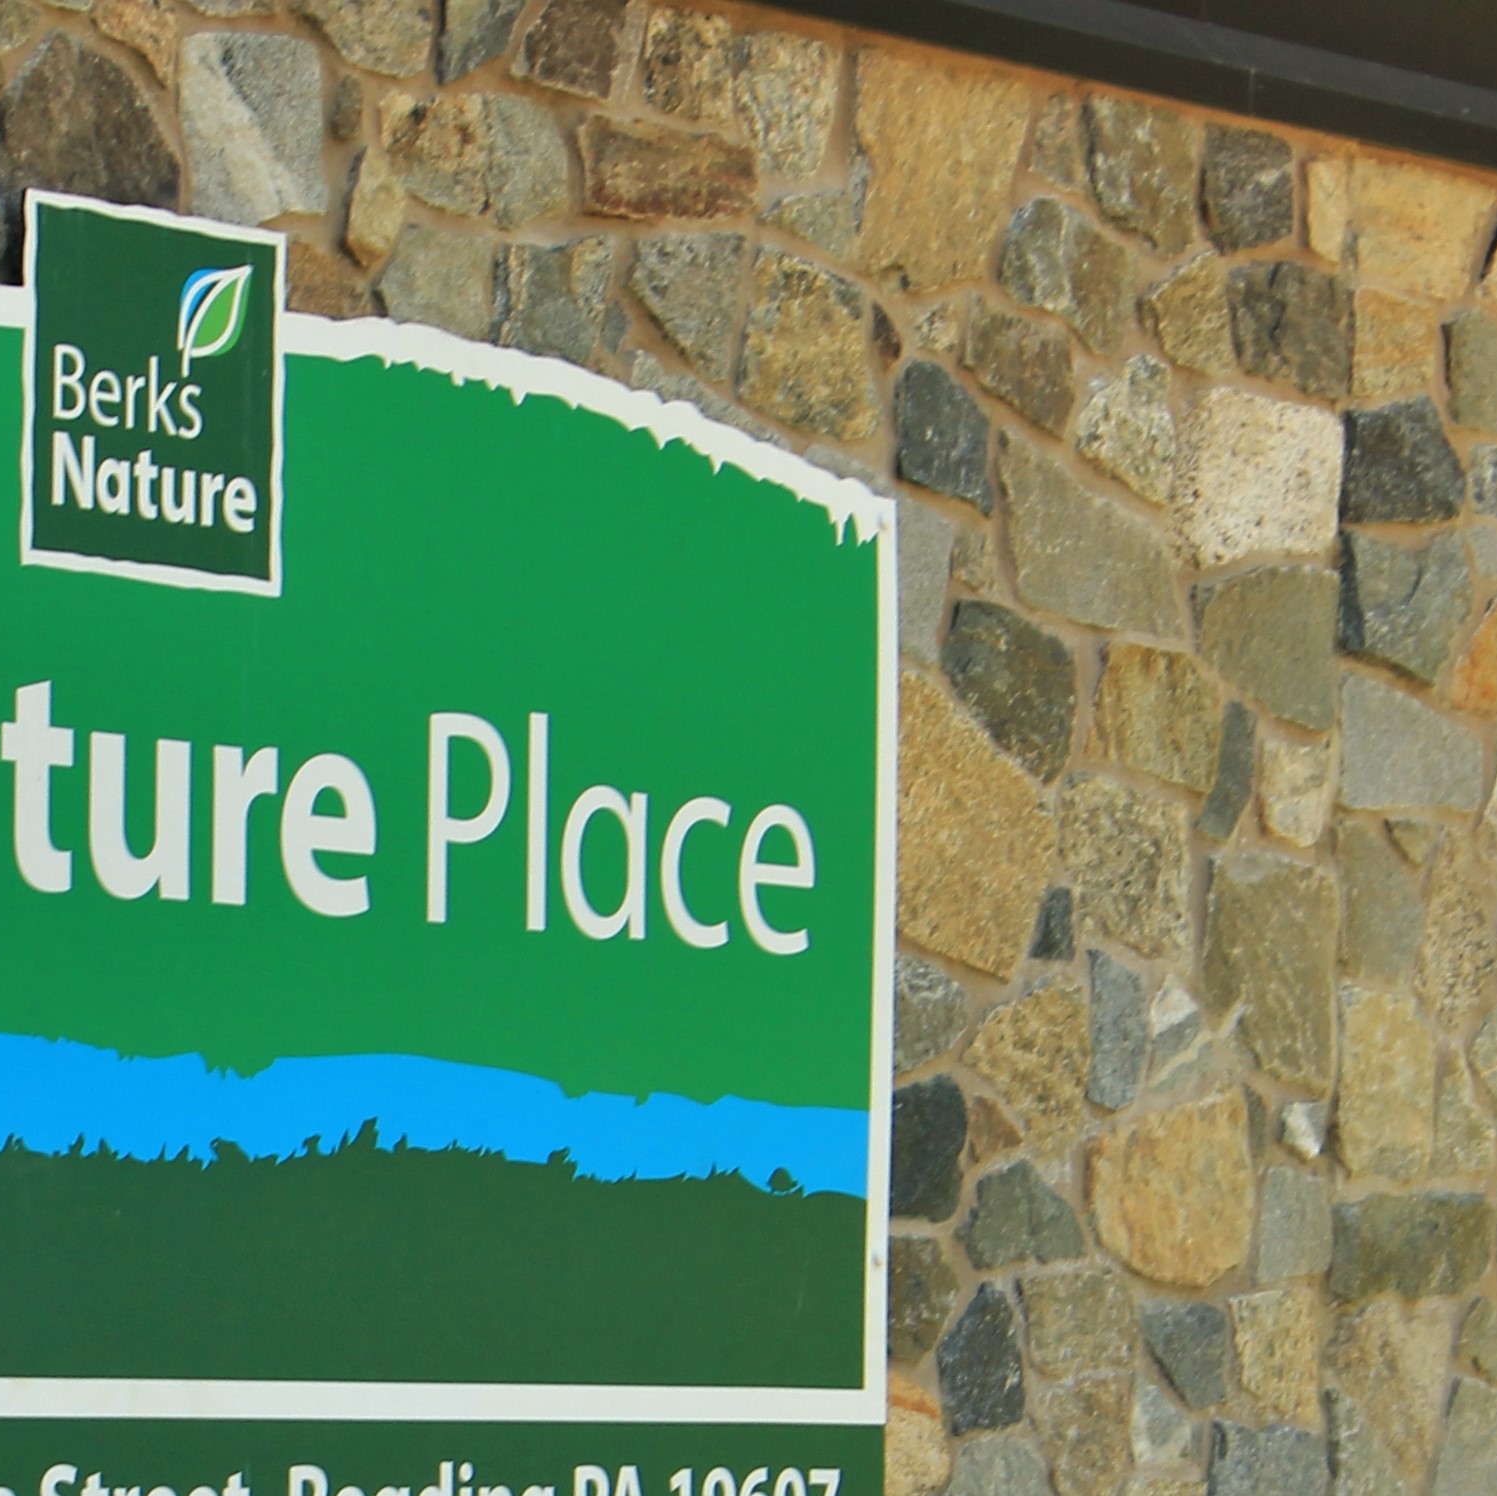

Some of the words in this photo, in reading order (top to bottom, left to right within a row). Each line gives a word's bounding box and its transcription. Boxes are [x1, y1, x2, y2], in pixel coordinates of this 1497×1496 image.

[53, 343, 203, 440] Berks
[51, 430, 259, 534] Nature
[425, 710, 817, 957] Place
